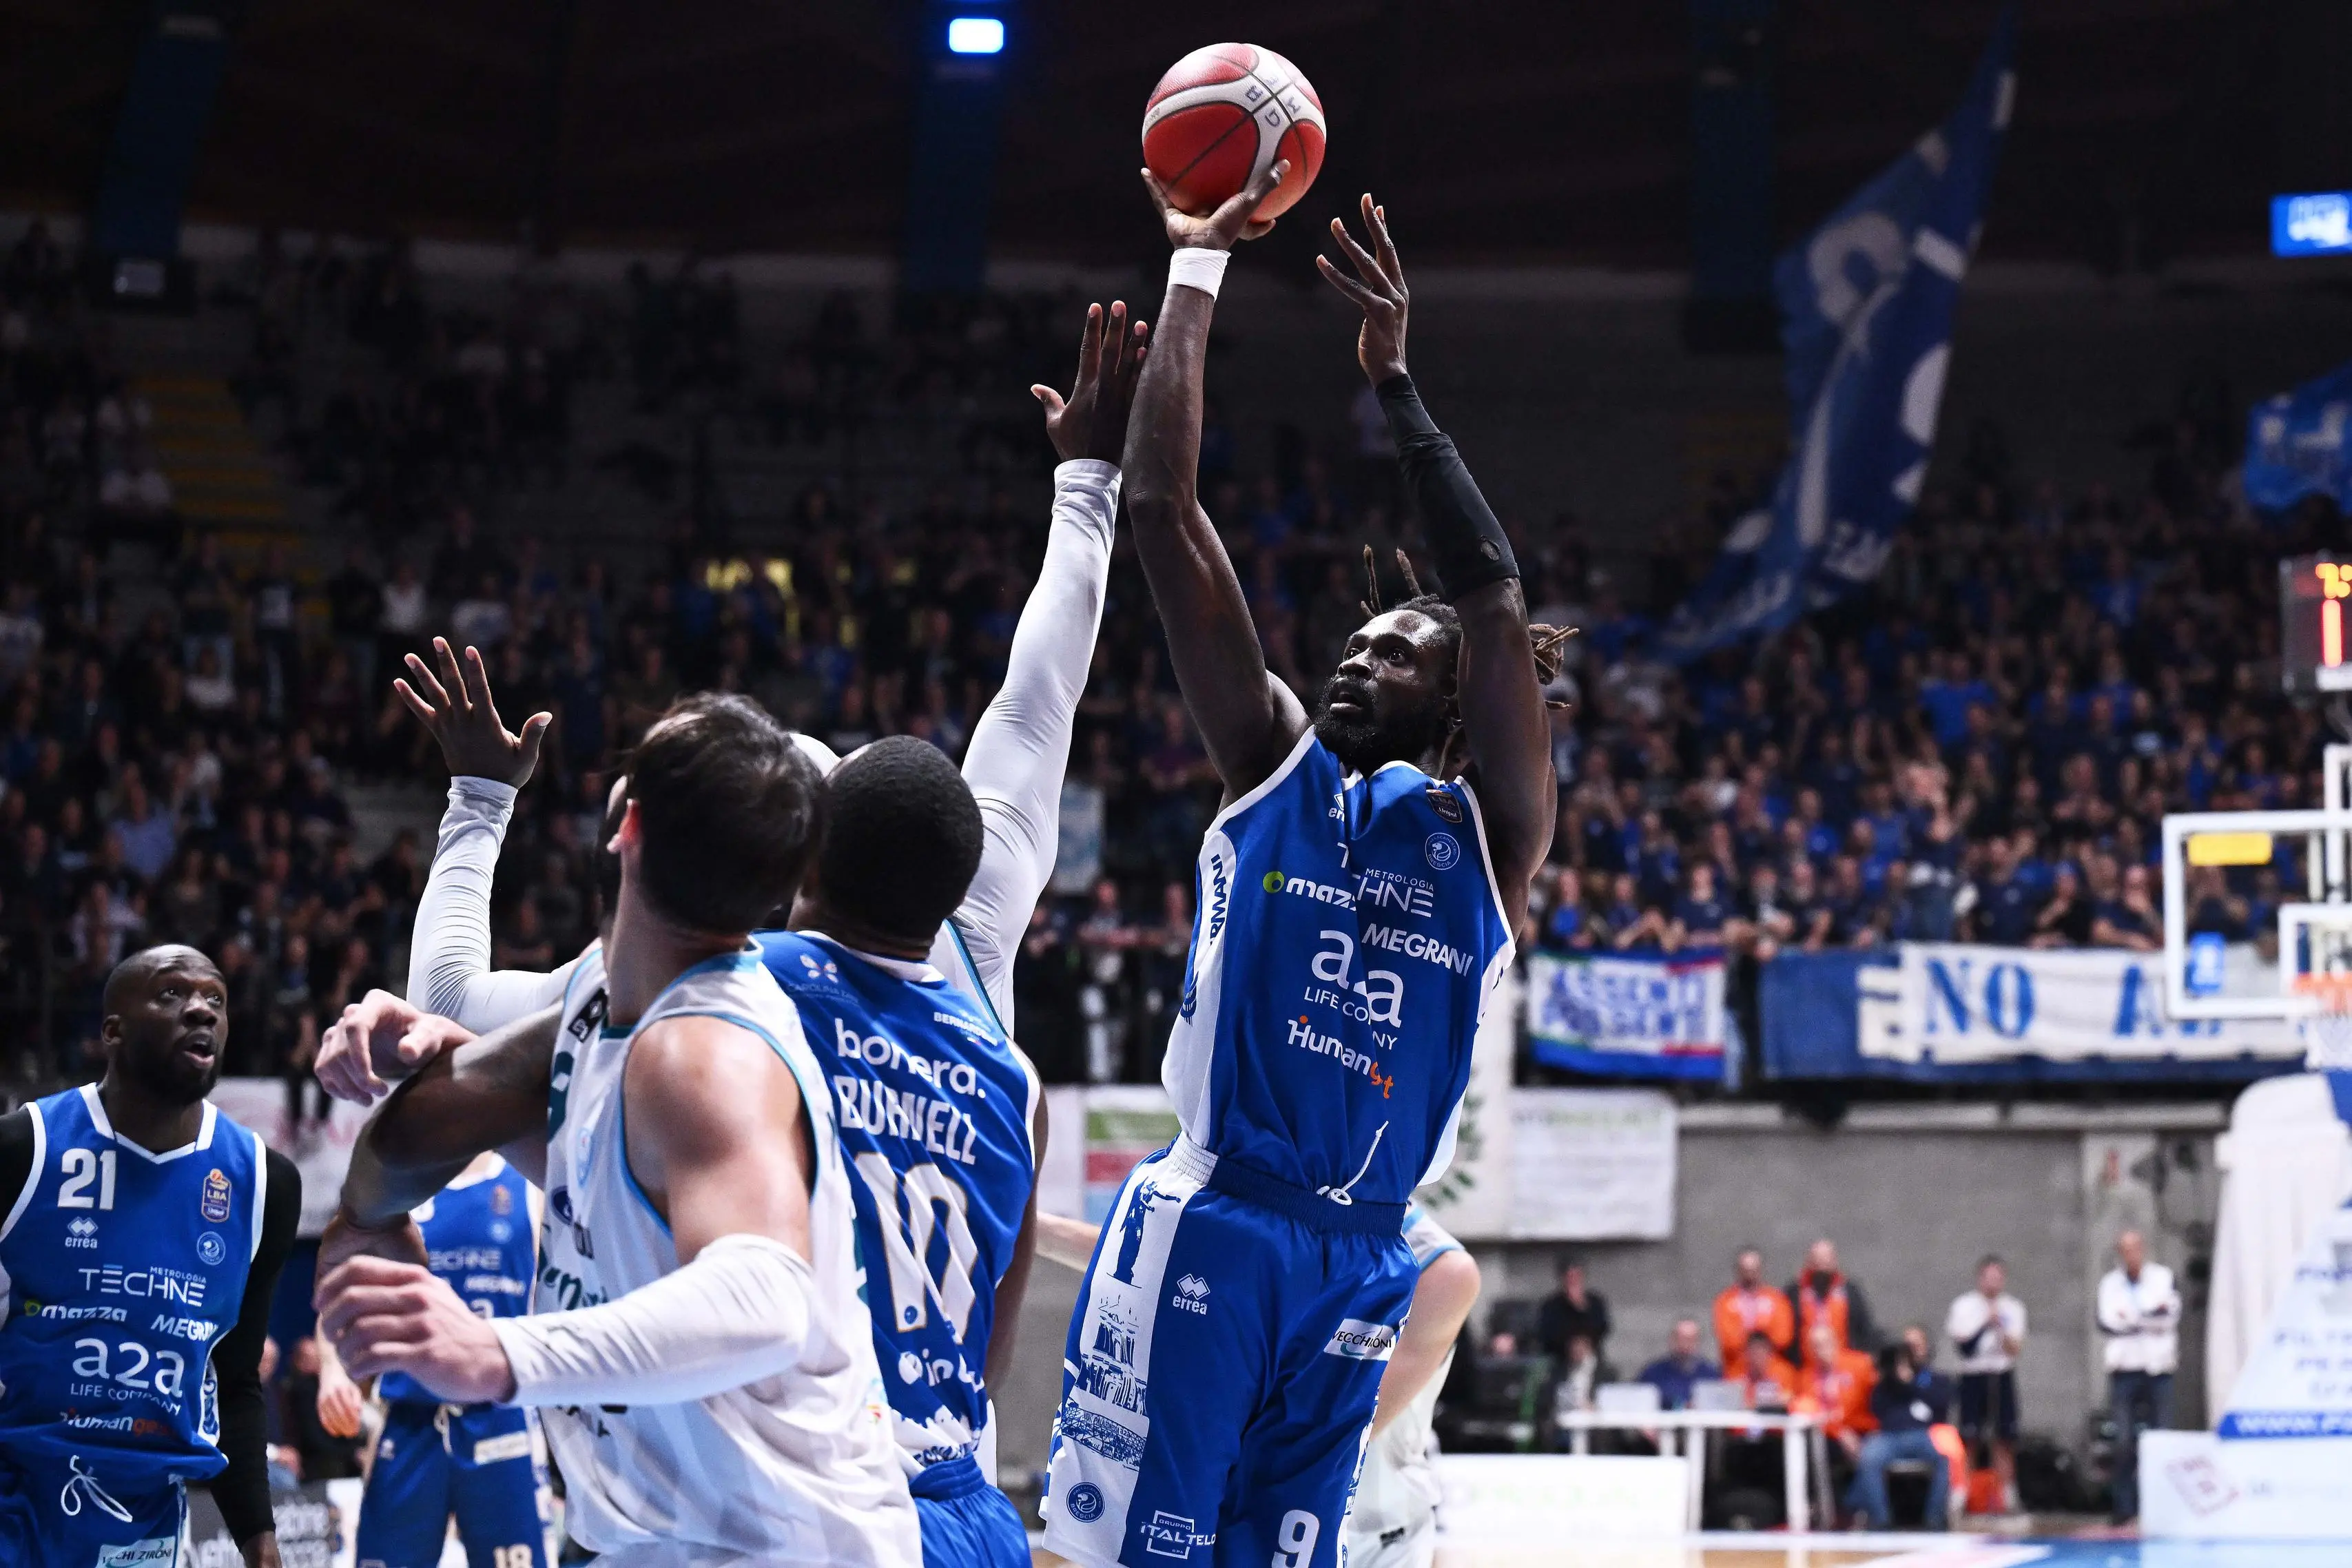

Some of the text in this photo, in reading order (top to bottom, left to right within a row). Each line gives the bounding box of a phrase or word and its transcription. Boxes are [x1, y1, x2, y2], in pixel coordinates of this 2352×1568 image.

[1427, 854, 1452, 867] BRESCIA
[1365, 867, 1434, 891] METROLOGIA
[1209, 853, 1227, 947] RMANI
[1361, 922, 1474, 978] MEGRANI
[1303, 986, 1339, 1010] LIFE
[1926, 958, 2036, 1036] NO
[57, 1148, 117, 1210] 21
[65, 1236, 98, 1249] errea
[149, 1266, 207, 1283] METROLOGIA
[41, 1303, 127, 1323] mazza
[1172, 1295, 1208, 1315] errea
[72, 1338, 185, 1398] a2a
[70, 1383, 103, 1398] LIFE
[1070, 1503, 1095, 1519] BRESCIA
[1159, 1518, 1191, 1530] GRUPPO
[1271, 1509, 1320, 1568] 9
